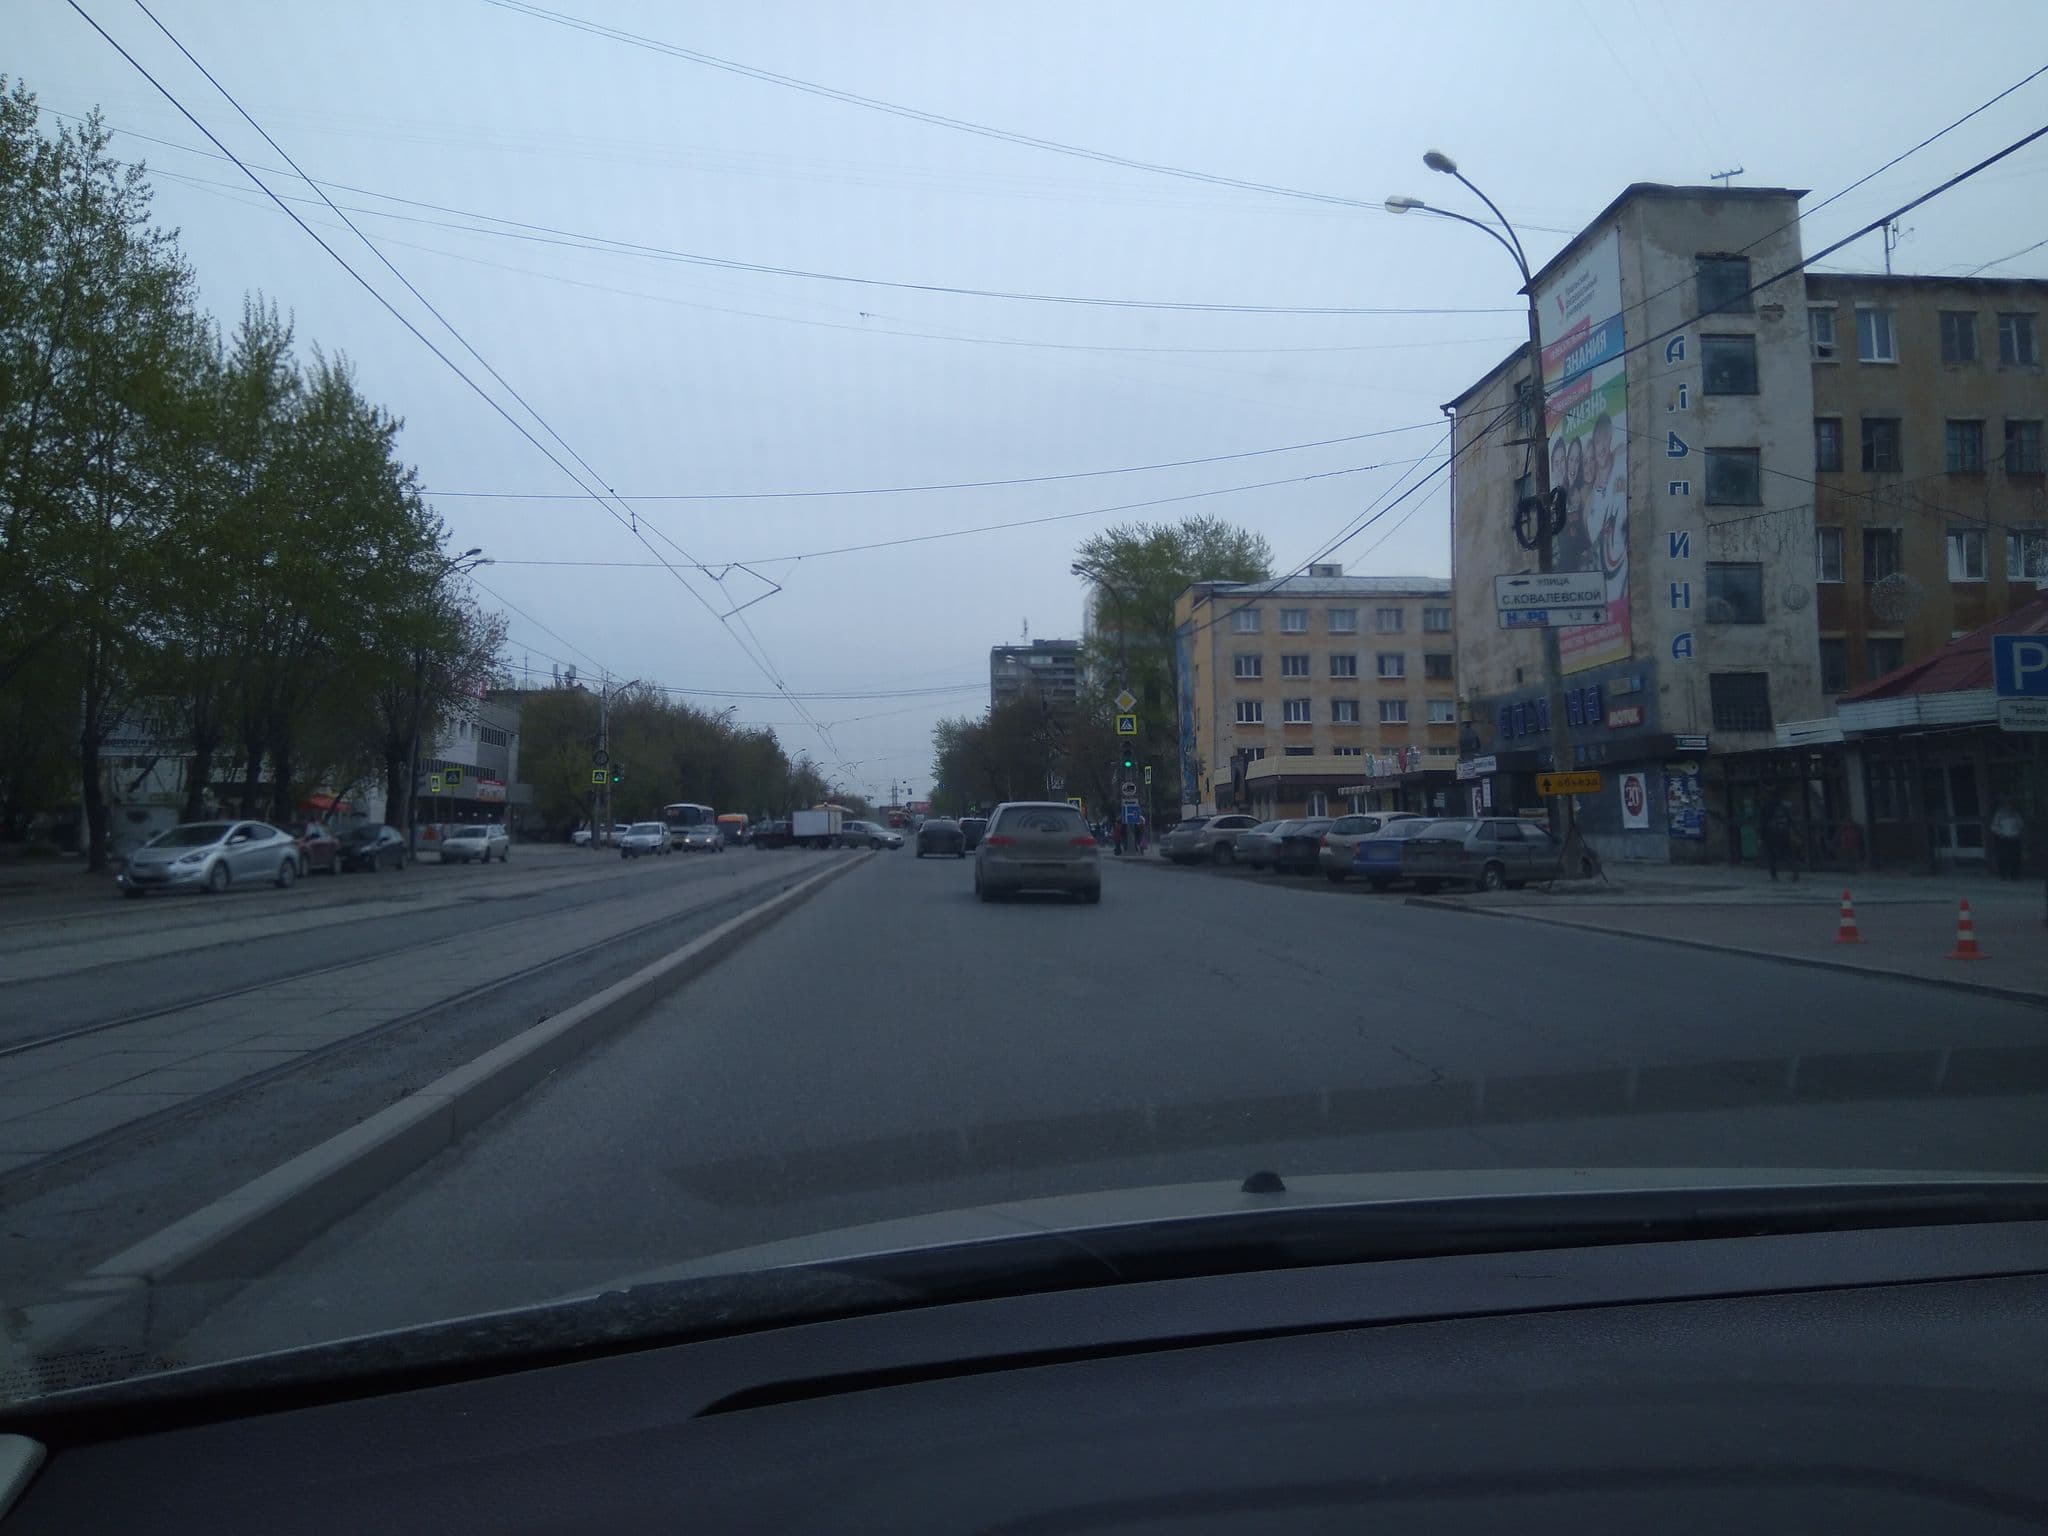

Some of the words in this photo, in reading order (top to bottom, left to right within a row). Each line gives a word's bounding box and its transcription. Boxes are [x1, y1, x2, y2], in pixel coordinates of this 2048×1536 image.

[1565, 331, 1607, 374] ЗНАНИЯ
[1566, 393, 1607, 434] ЖИЗНЬ
[2011, 642, 2048, 690] P
